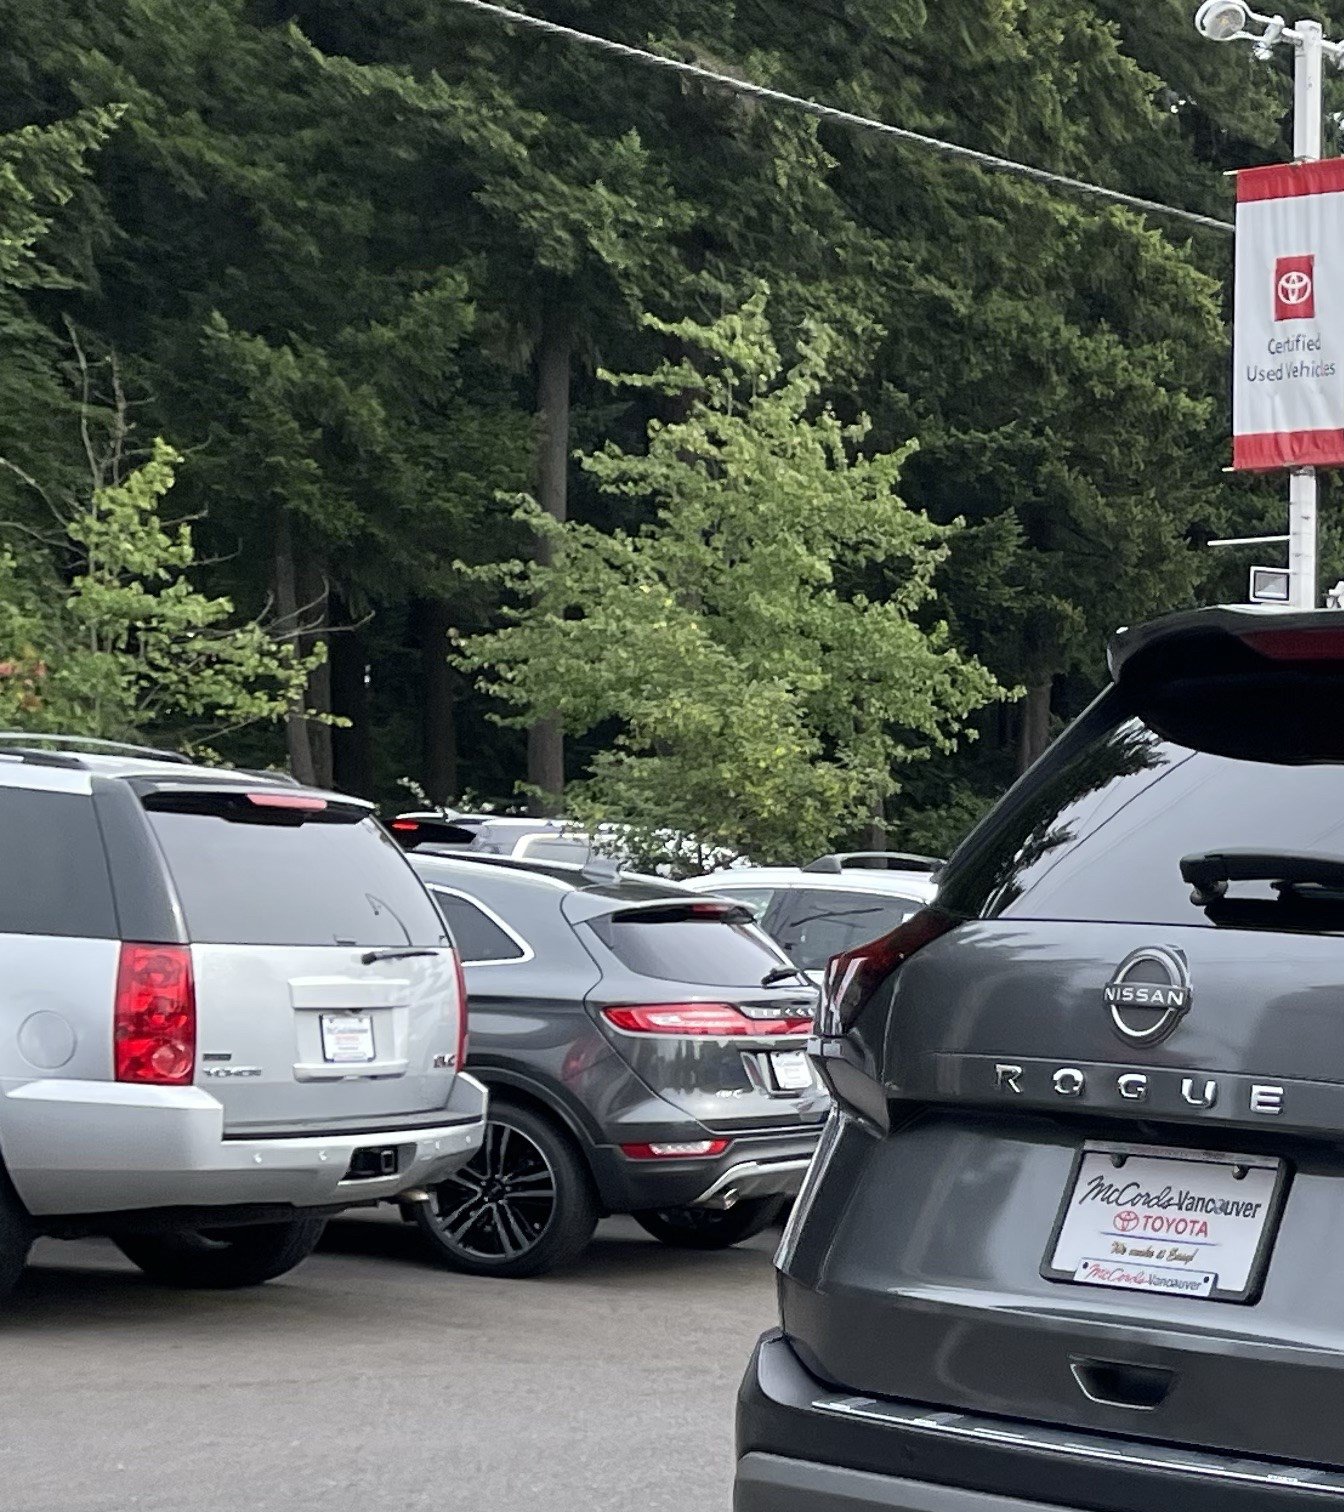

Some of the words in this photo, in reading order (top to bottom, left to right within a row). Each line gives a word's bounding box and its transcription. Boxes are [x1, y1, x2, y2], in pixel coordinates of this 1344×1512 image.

[1268, 332, 1321, 355] Certified
[1247, 364, 1284, 382] Used
[1285, 360, 1335, 380] Vehicles
[1104, 986, 1184, 1006] NISSAN
[995, 1063, 1285, 1115] ROGUE
[1177, 1190, 1262, 1218] Vancouver
[1143, 1215, 1209, 1237] TOYOTA
